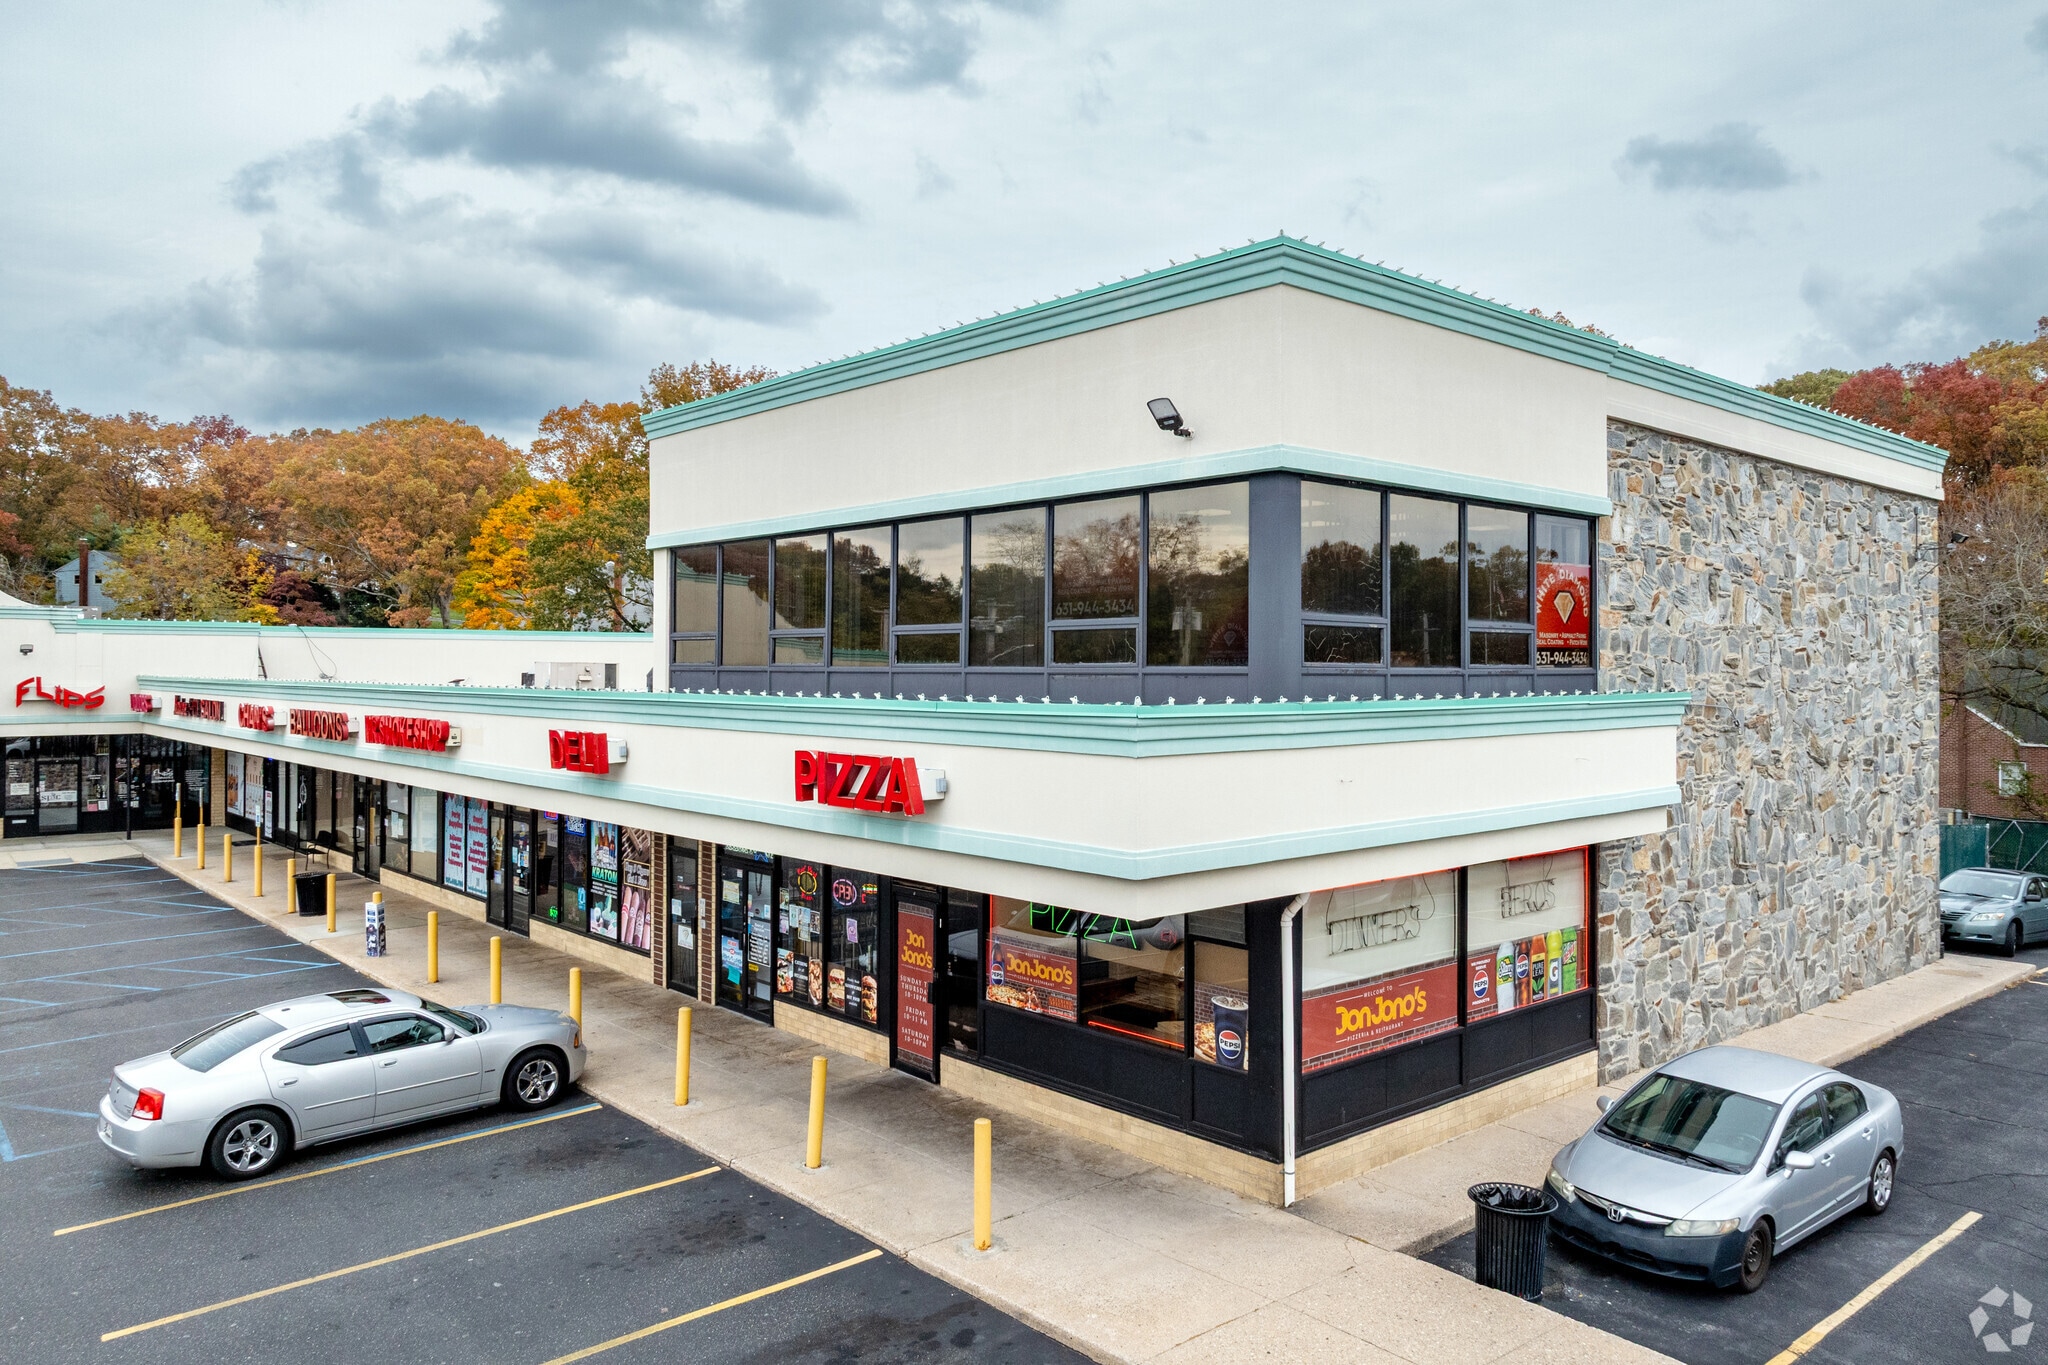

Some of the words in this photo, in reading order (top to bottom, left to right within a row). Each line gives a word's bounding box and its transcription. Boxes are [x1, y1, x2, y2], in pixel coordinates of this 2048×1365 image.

[1536, 573, 1555, 613] WHITE
[1559, 569, 1588, 617] DIAMOND
[1055, 599, 1135, 616] 631-944-3434
[1536, 651, 1588, 664] 631-944-3434
[290, 708, 349, 742] BALLOONS
[548, 729, 610, 775] DELI
[794, 750, 926, 817] PIZZA
[592, 866, 618, 884] KRATOM
[1501, 878, 1557, 918] HEROS
[906, 929, 925, 949] Jon
[901, 946, 933, 969] Jono's
[1006, 952, 1031, 976] Jon
[1030, 959, 1073, 985] Jono's
[900, 974, 922, 986] SUNDAY
[901, 982, 929, 996] THURSDA
[1474, 980, 1488, 989] PEPSI
[1363, 986, 1385, 998] WELCOME
[905, 1005, 926, 1018] FRIDAY
[1335, 1006, 1371, 1036] Jon
[1370, 986, 1427, 1025] Jono's
[901, 1026, 930, 1042] SATURDAY
[1347, 1031, 1369, 1042] PIZZERIA
[1375, 1021, 1404, 1034] RESTAURANT
